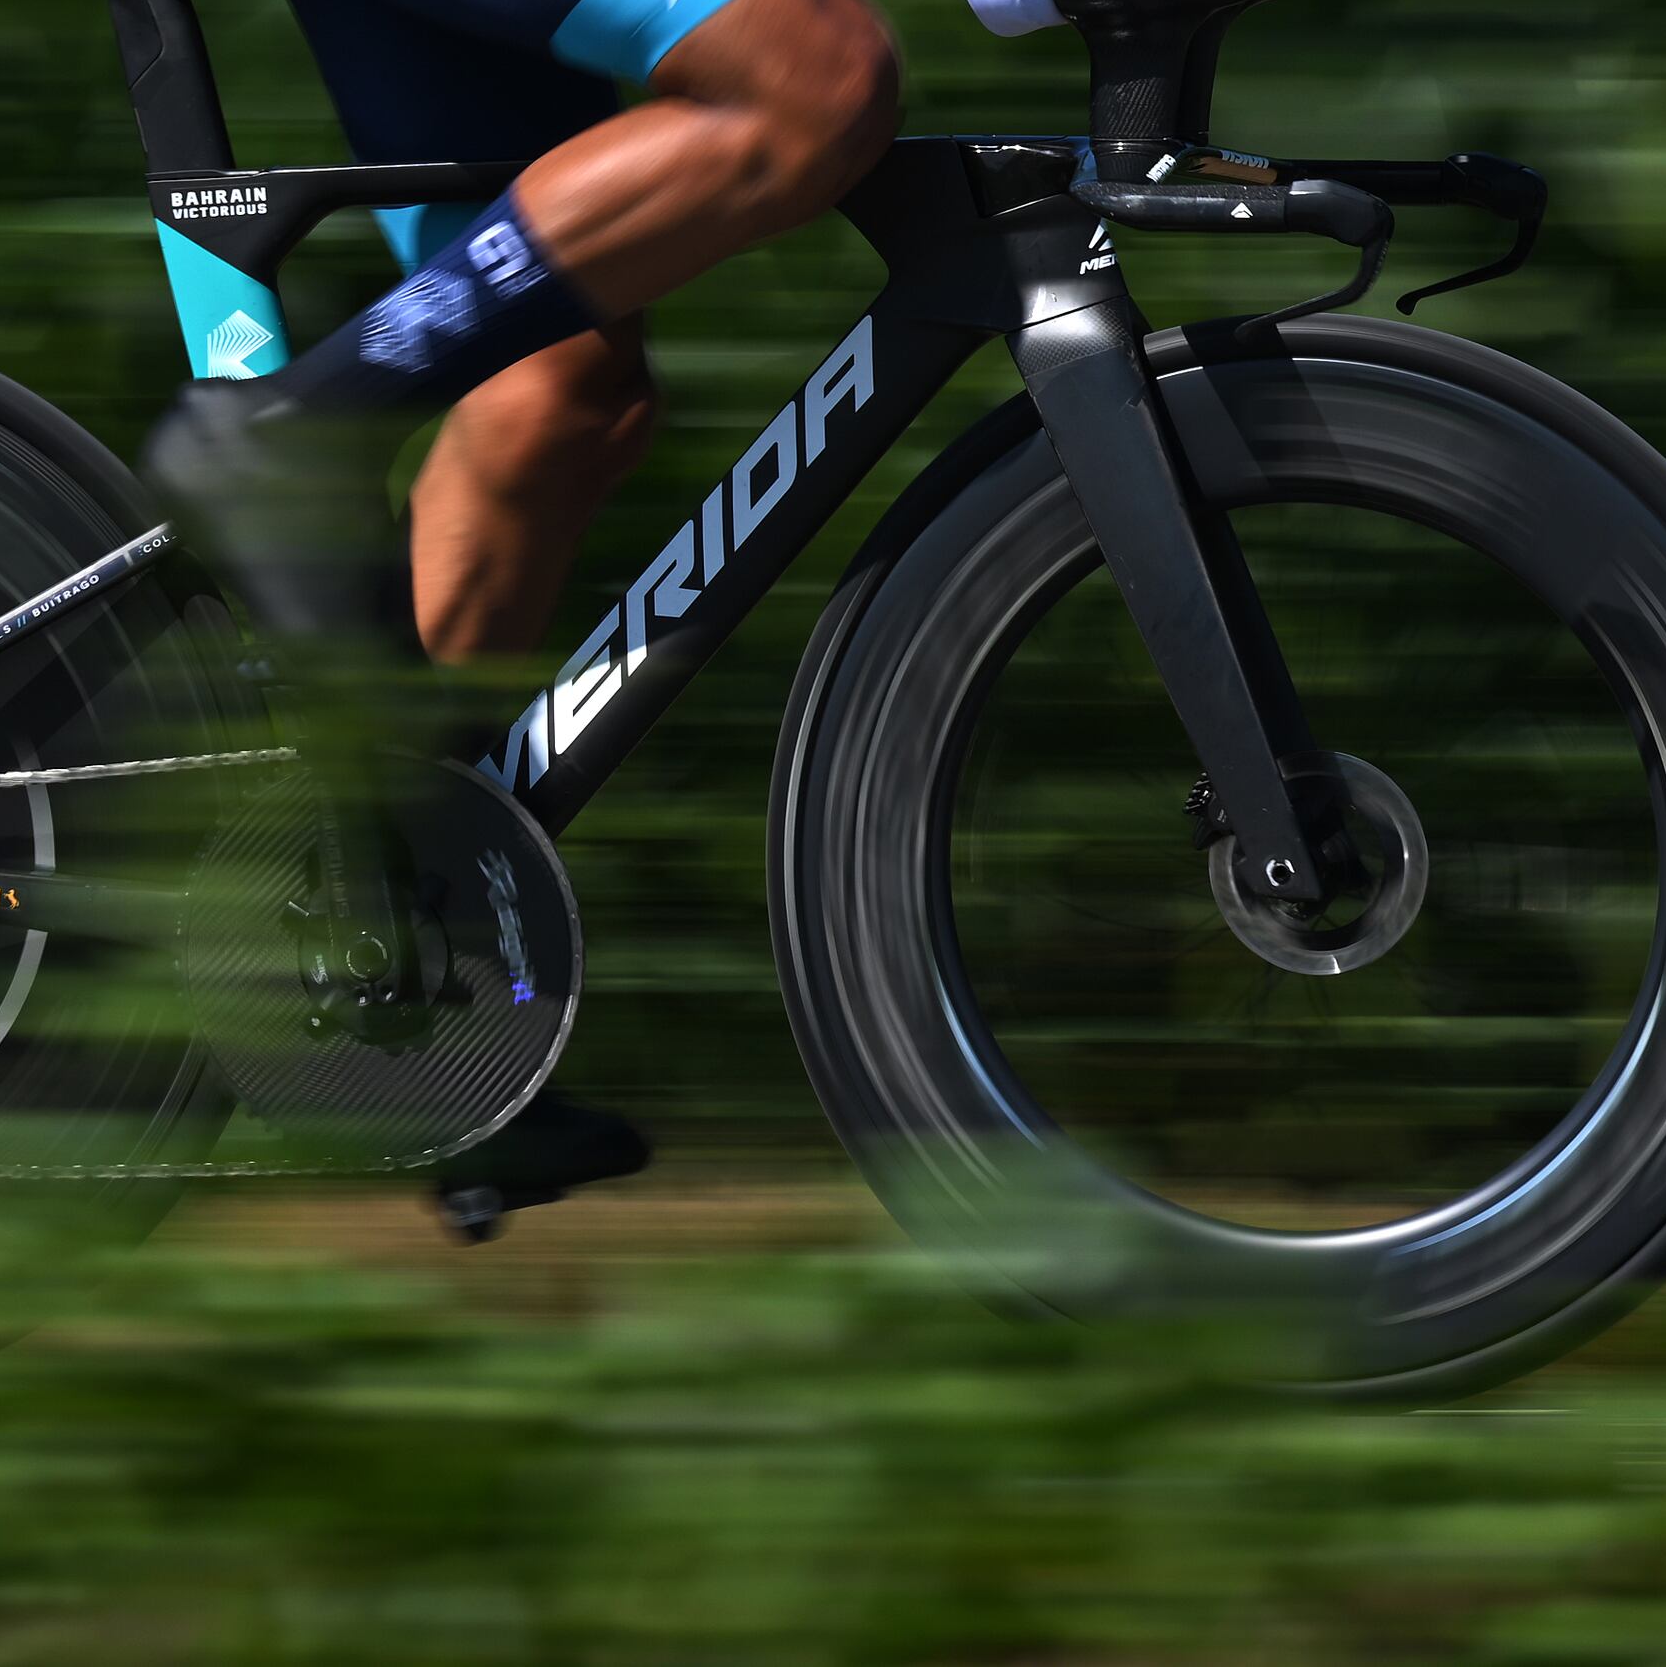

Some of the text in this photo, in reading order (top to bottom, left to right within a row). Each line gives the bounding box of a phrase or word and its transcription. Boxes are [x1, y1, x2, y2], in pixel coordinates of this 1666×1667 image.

[171, 187, 267, 207] BAHRAIN
[173, 203, 268, 220] VICTORIOUS
[143, 535, 170, 553] COL
[476, 315, 875, 794] MERIDA
[31, 574, 101, 618] BUITRAGO
